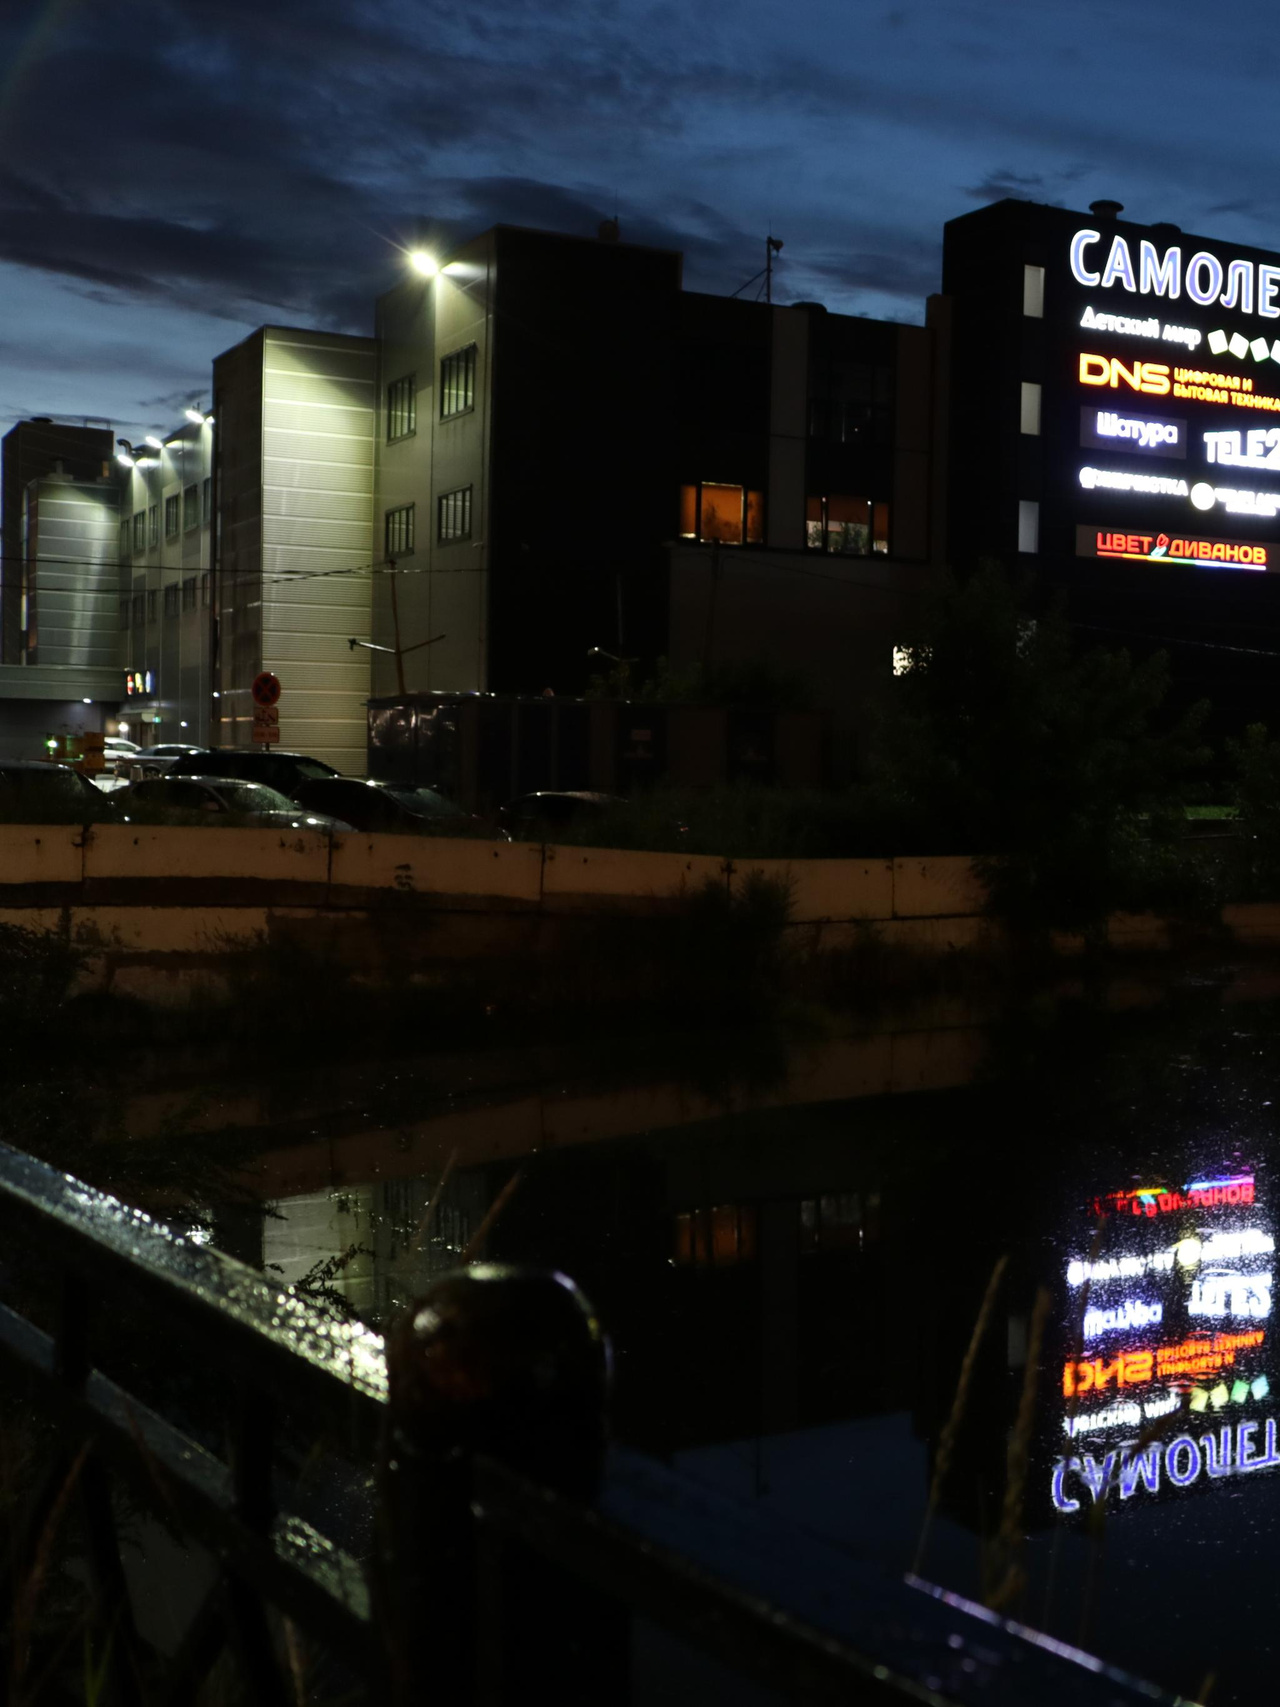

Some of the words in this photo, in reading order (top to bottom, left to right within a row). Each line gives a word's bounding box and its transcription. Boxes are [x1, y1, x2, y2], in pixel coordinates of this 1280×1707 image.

[1080, 306, 1160, 339] Детский
[1162, 324, 1202, 351] мир
[1079, 353, 1171, 395] DNS
[1174, 367, 1241, 390] ЦИФРОВАЯ
[1242, 378, 1253, 392] И
[1173, 383, 1229, 404] БЫТОВАЯ
[1097, 411, 1178, 447] Шатура
[1096, 532, 1153, 553] ЦВЕТ
[1168, 540, 1267, 565] ДИВАНОВ
